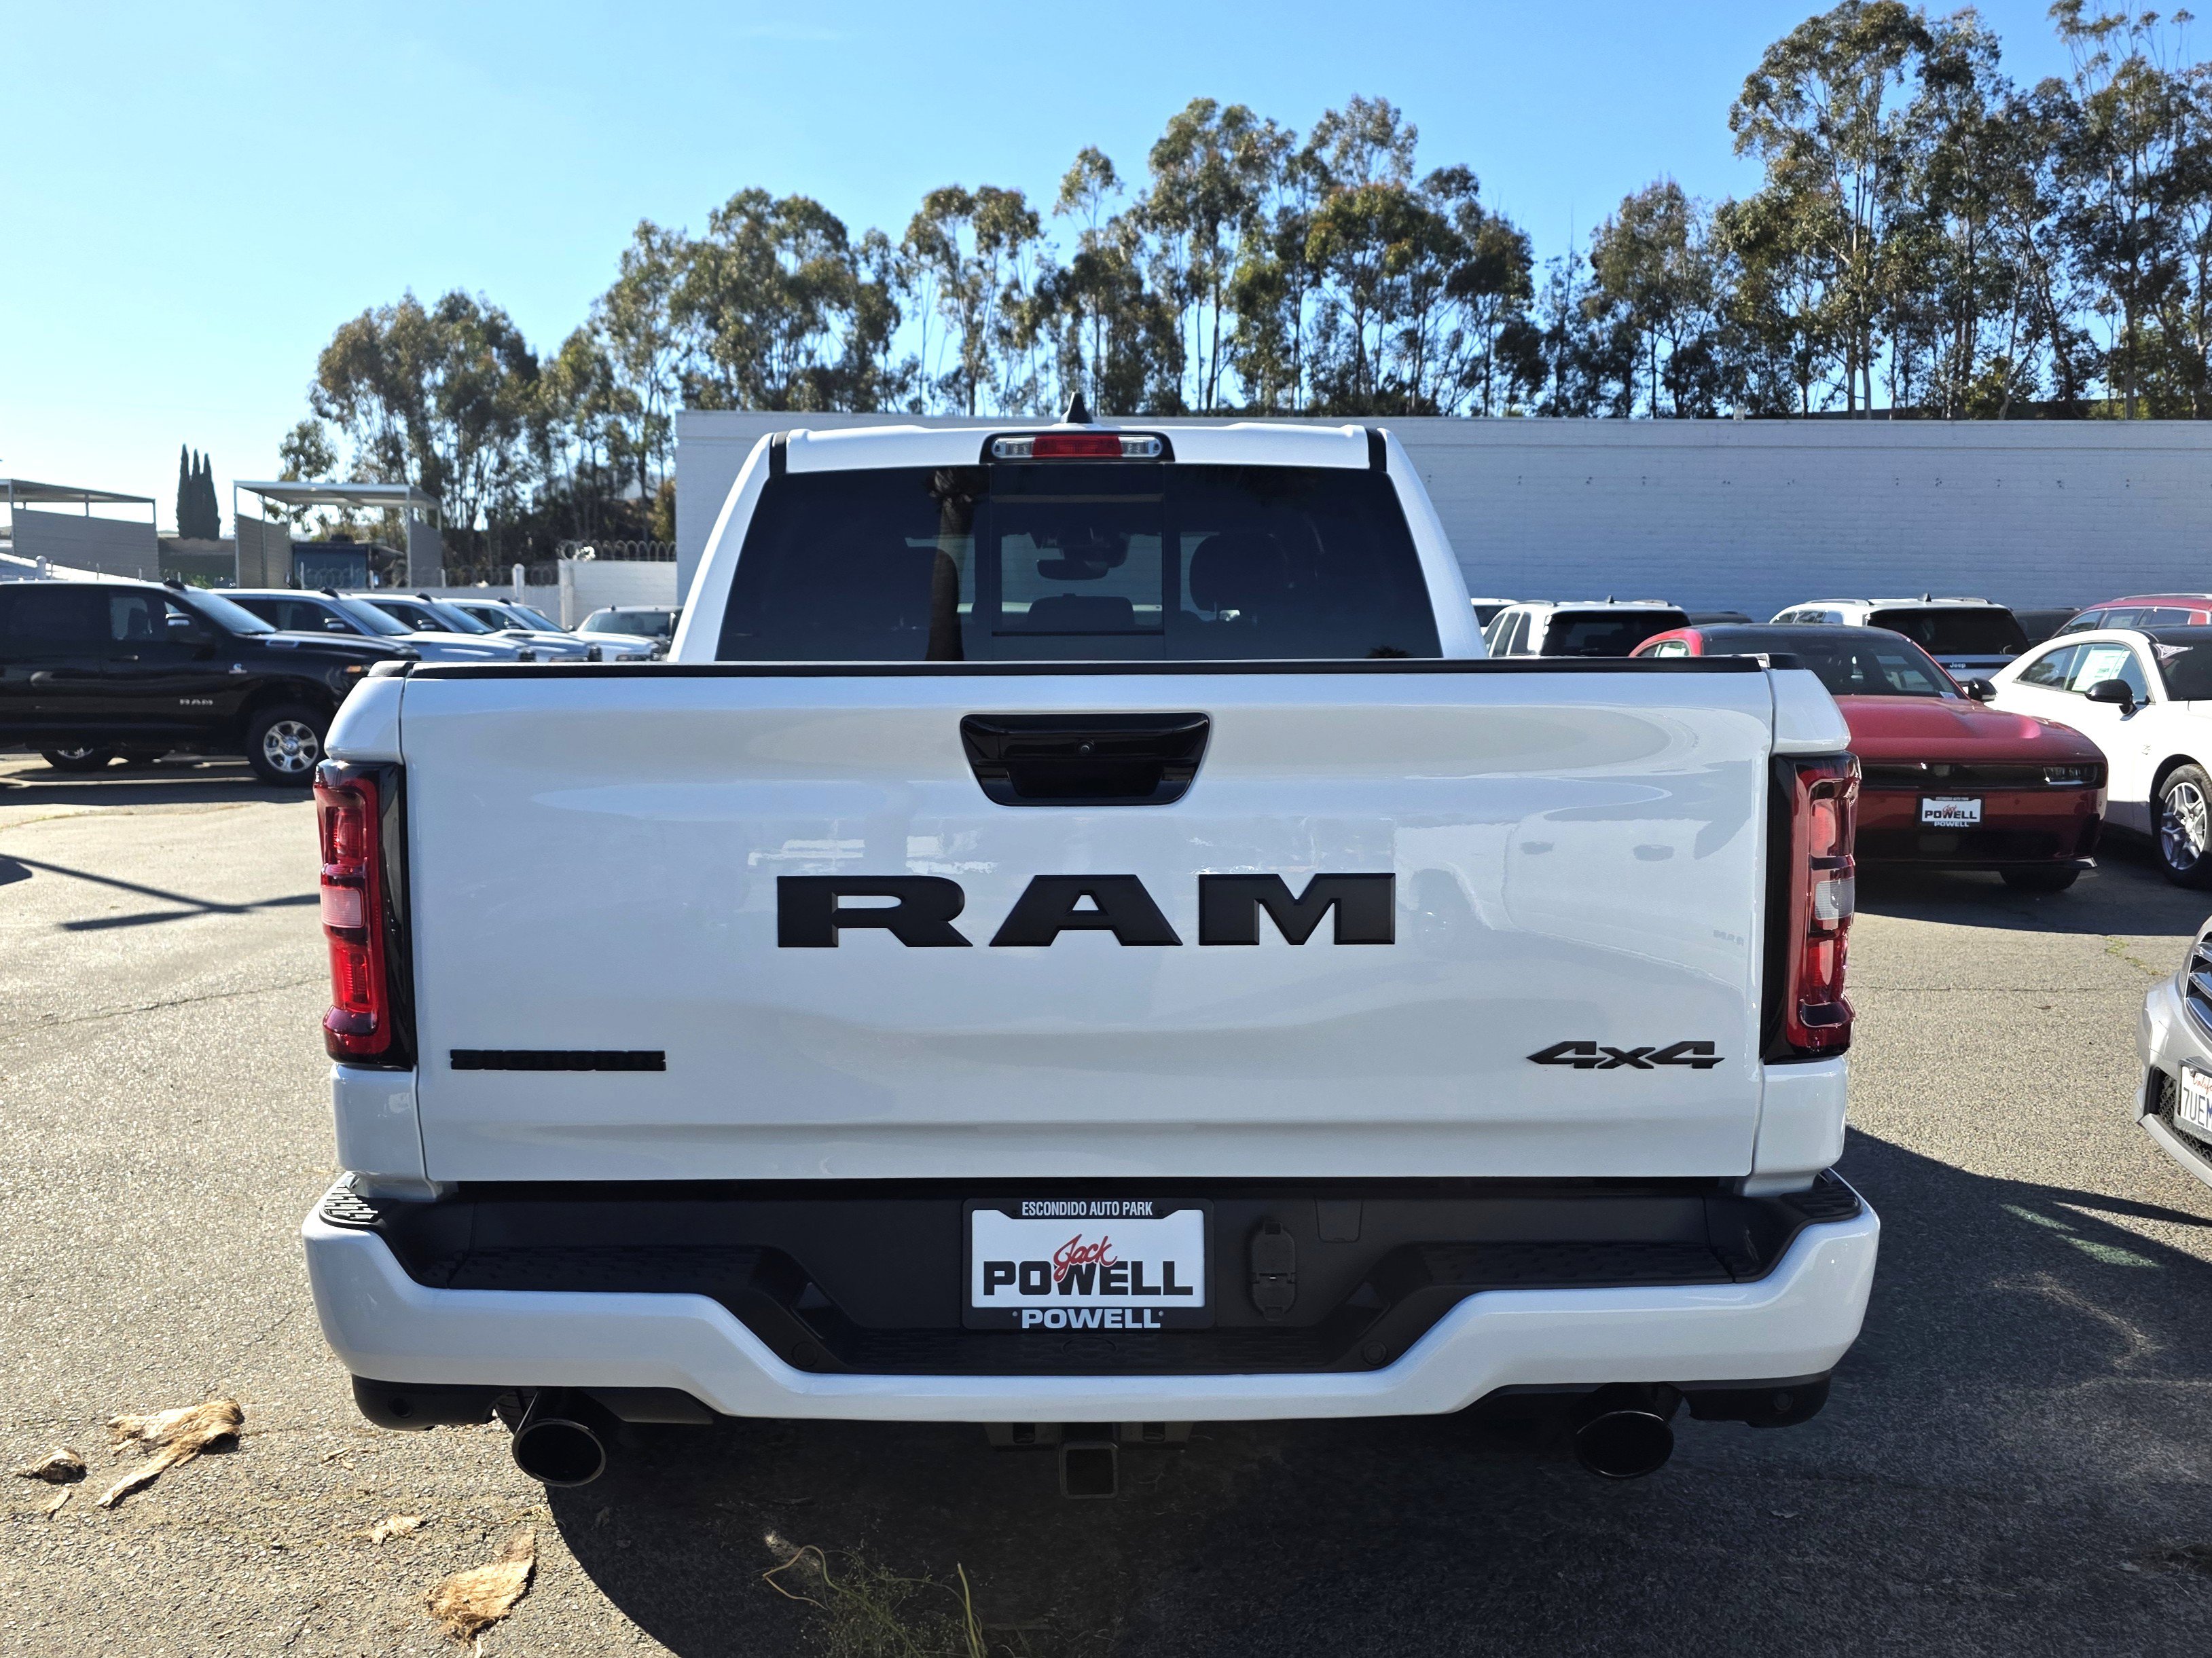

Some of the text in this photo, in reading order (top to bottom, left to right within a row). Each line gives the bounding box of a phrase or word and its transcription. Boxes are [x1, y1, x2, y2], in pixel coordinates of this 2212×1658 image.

[1924, 810, 1977, 819] POWELL
[776, 872, 1396, 948] RAM
[1525, 1040, 1726, 1069] 4x4
[1021, 1201, 1153, 1216] ESCONDIDO AUTO PARK
[1053, 1233, 1118, 1283] Jack
[983, 1260, 1193, 1295] POWELL
[1021, 1308, 1161, 1329] POWELL
